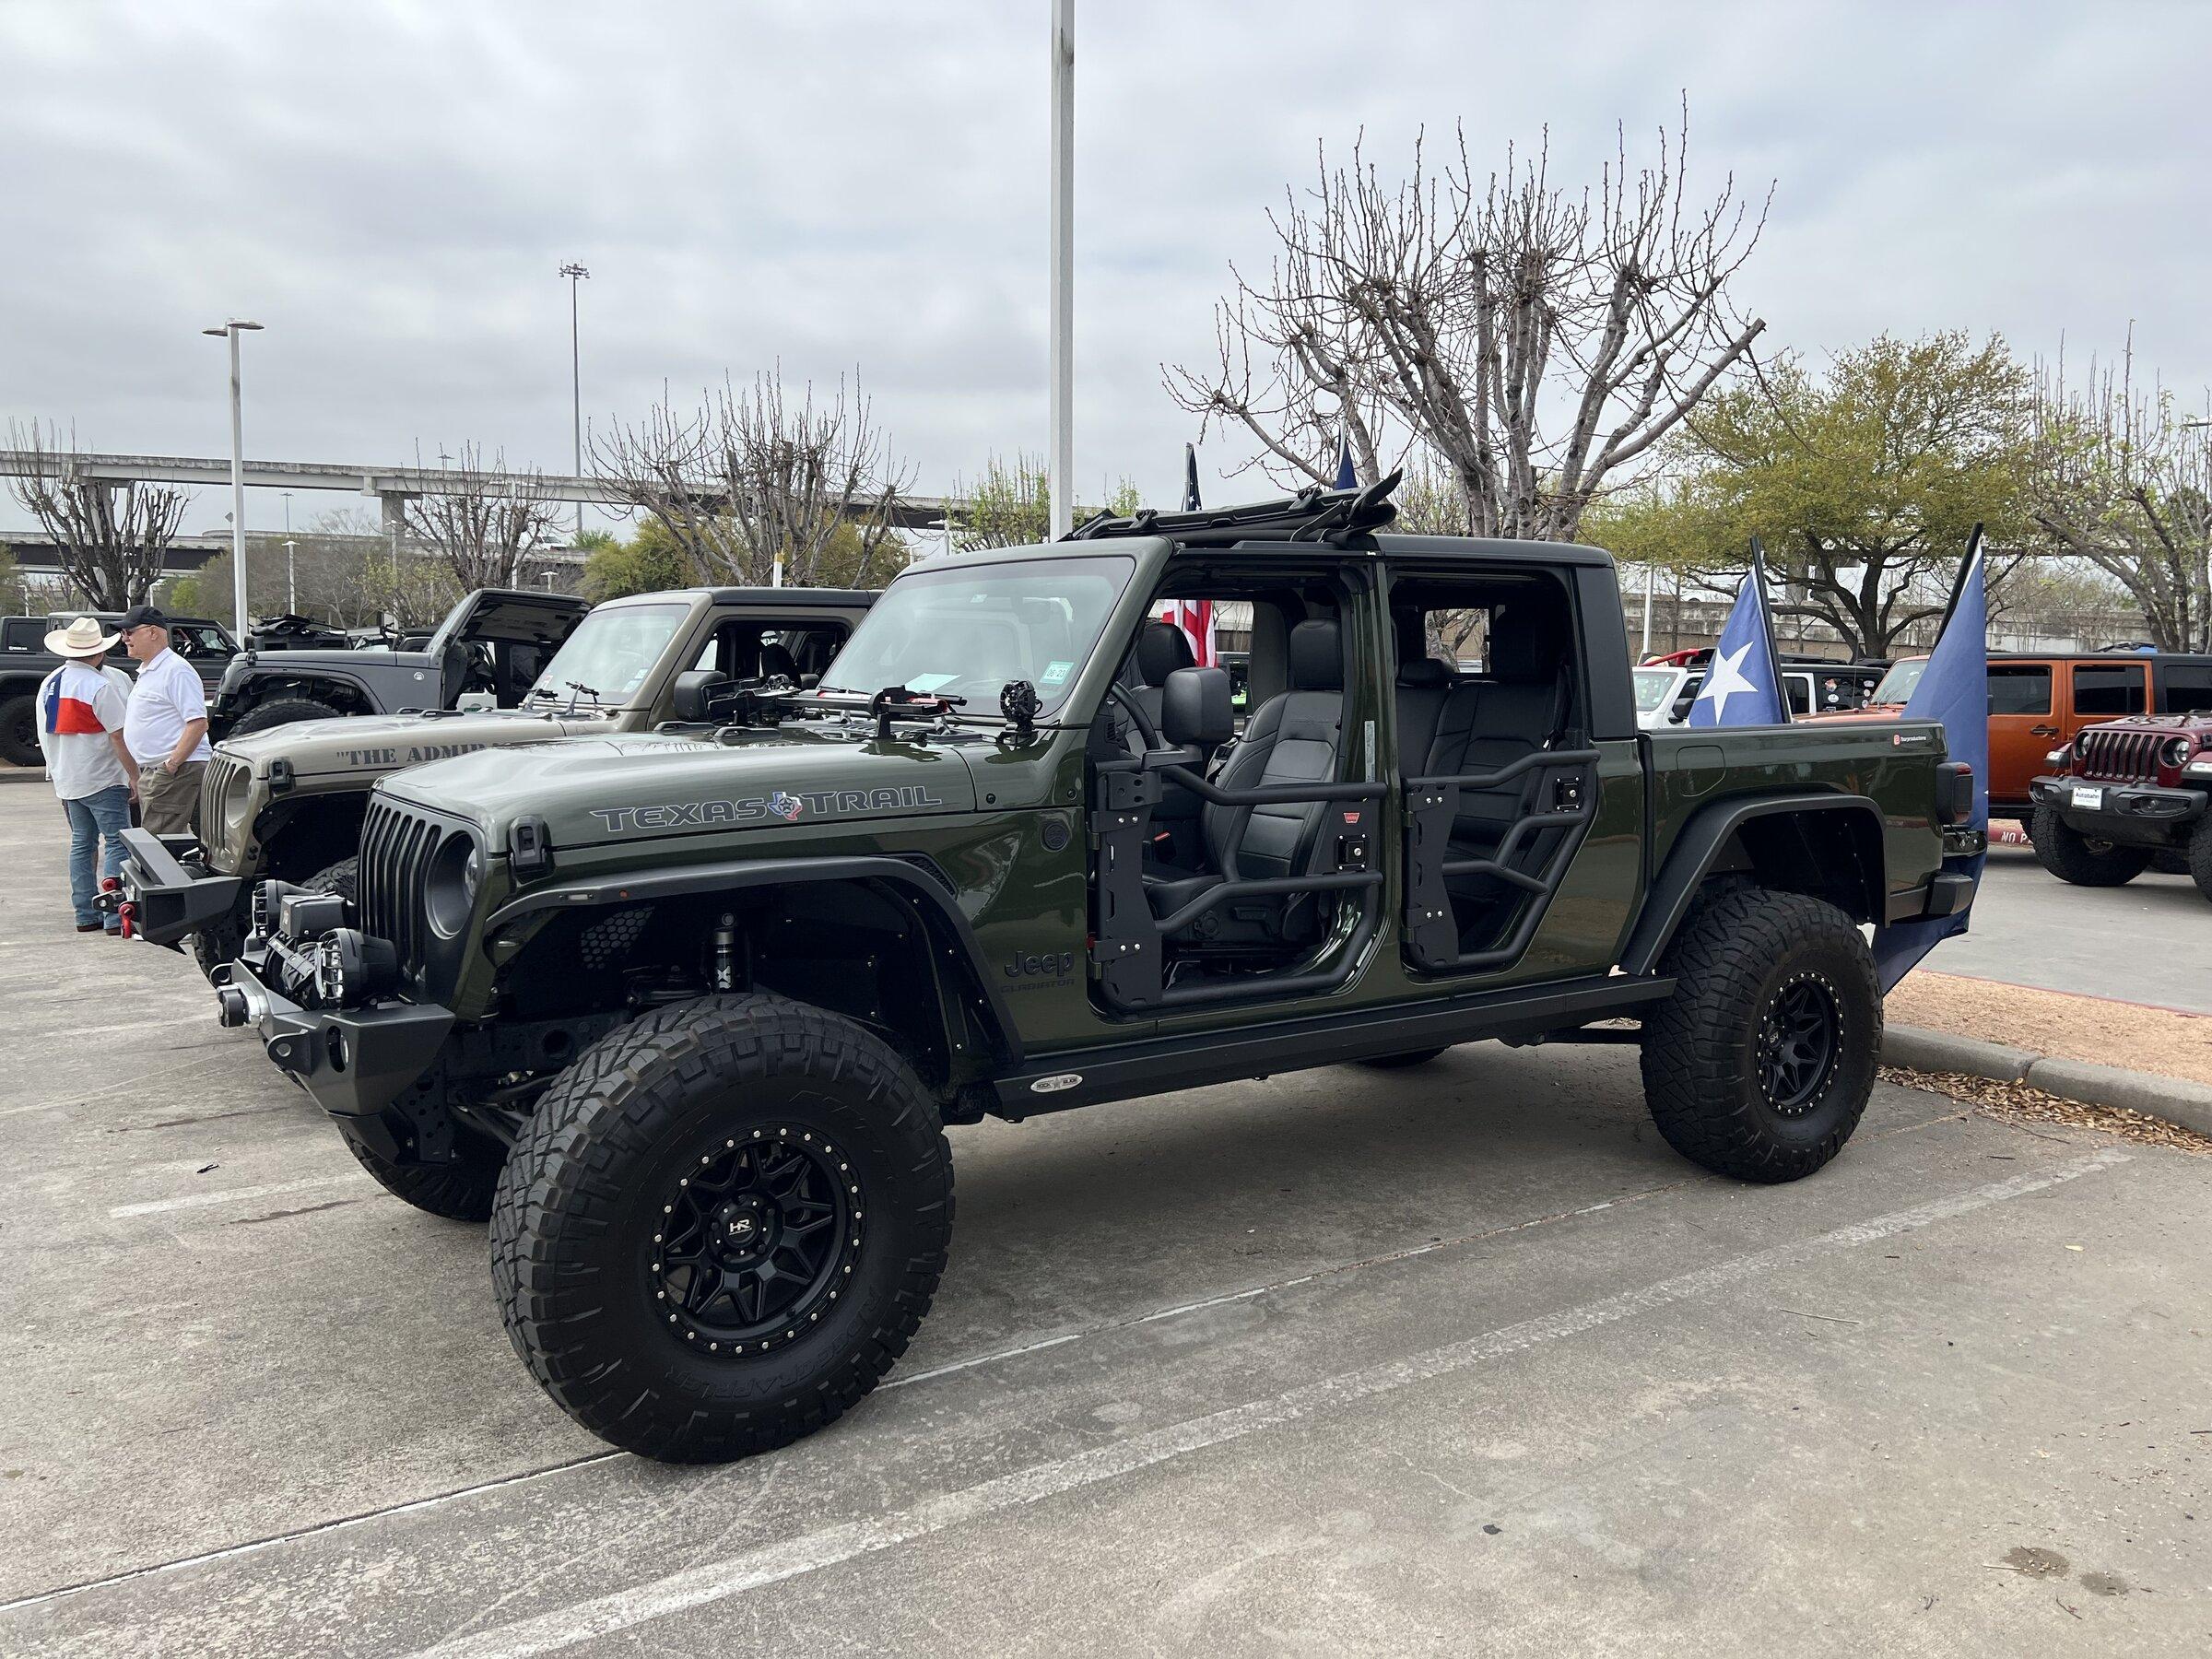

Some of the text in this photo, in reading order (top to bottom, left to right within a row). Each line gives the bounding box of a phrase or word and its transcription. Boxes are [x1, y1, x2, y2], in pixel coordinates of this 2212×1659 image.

[589, 785, 942, 832] TEXAS TRAIL
[2001, 830, 2016, 842] NO
[1004, 950, 1075, 977] Jeep
[1001, 978, 1076, 994] GLADIATOR
